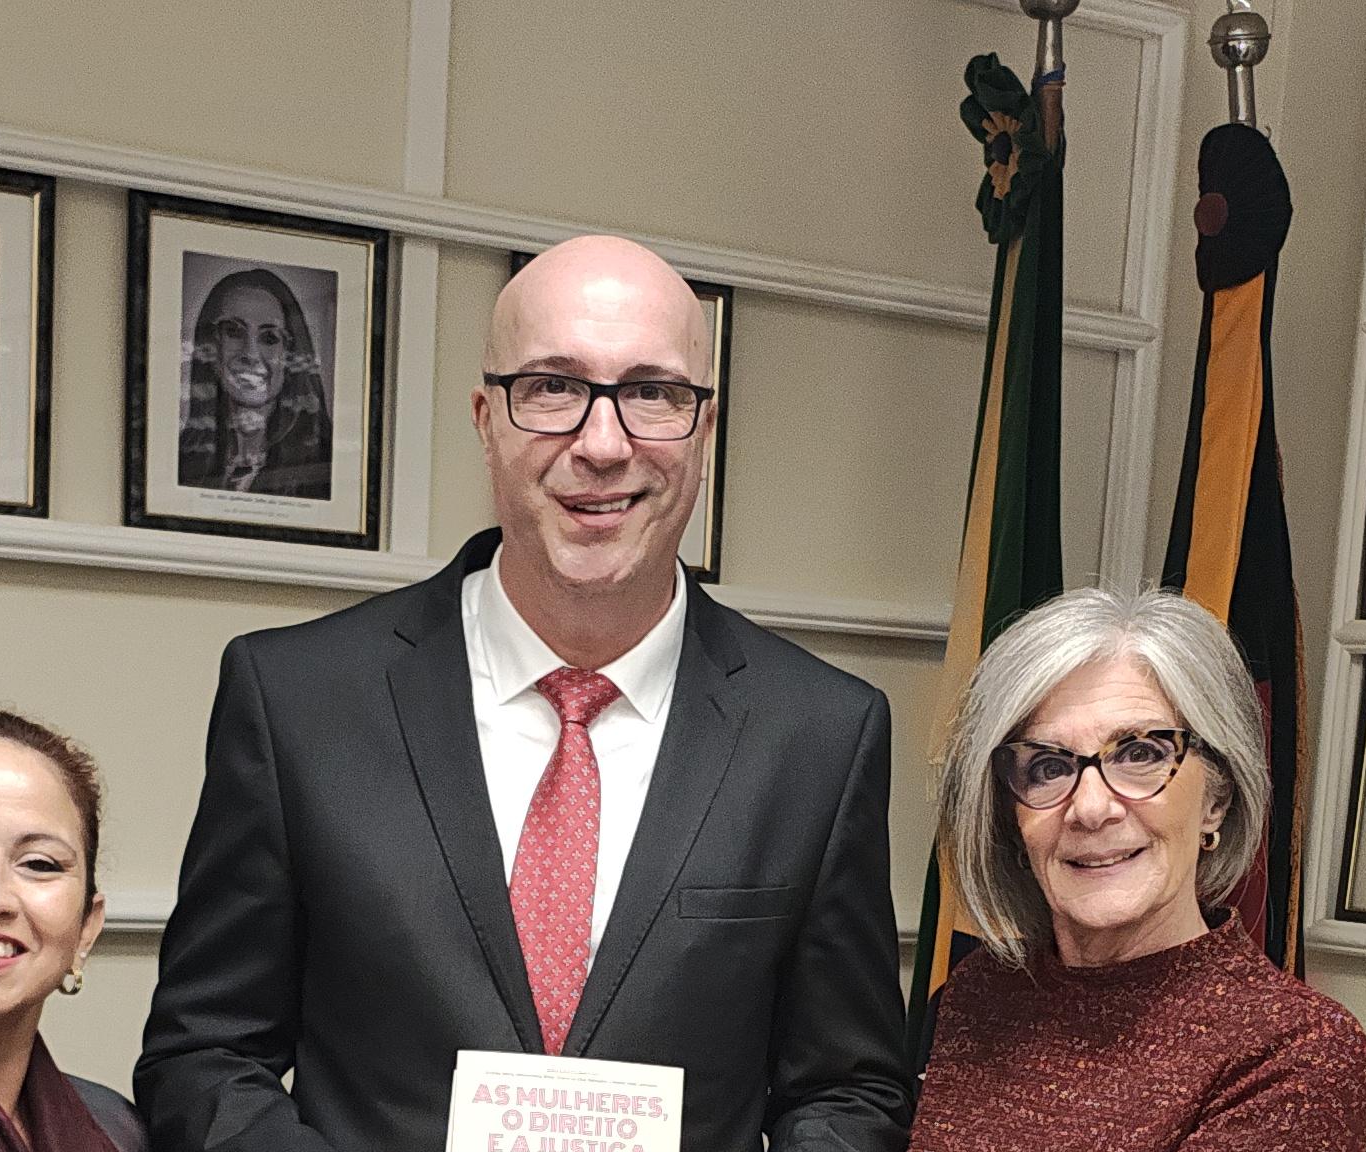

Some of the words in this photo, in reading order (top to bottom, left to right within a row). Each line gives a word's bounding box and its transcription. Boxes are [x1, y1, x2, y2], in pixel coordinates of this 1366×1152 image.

[472, 1083, 510, 1106] AS
[516, 1086, 668, 1121] MULHERES,
[502, 1109, 523, 1131] O
[529, 1111, 638, 1140] DIREITO
